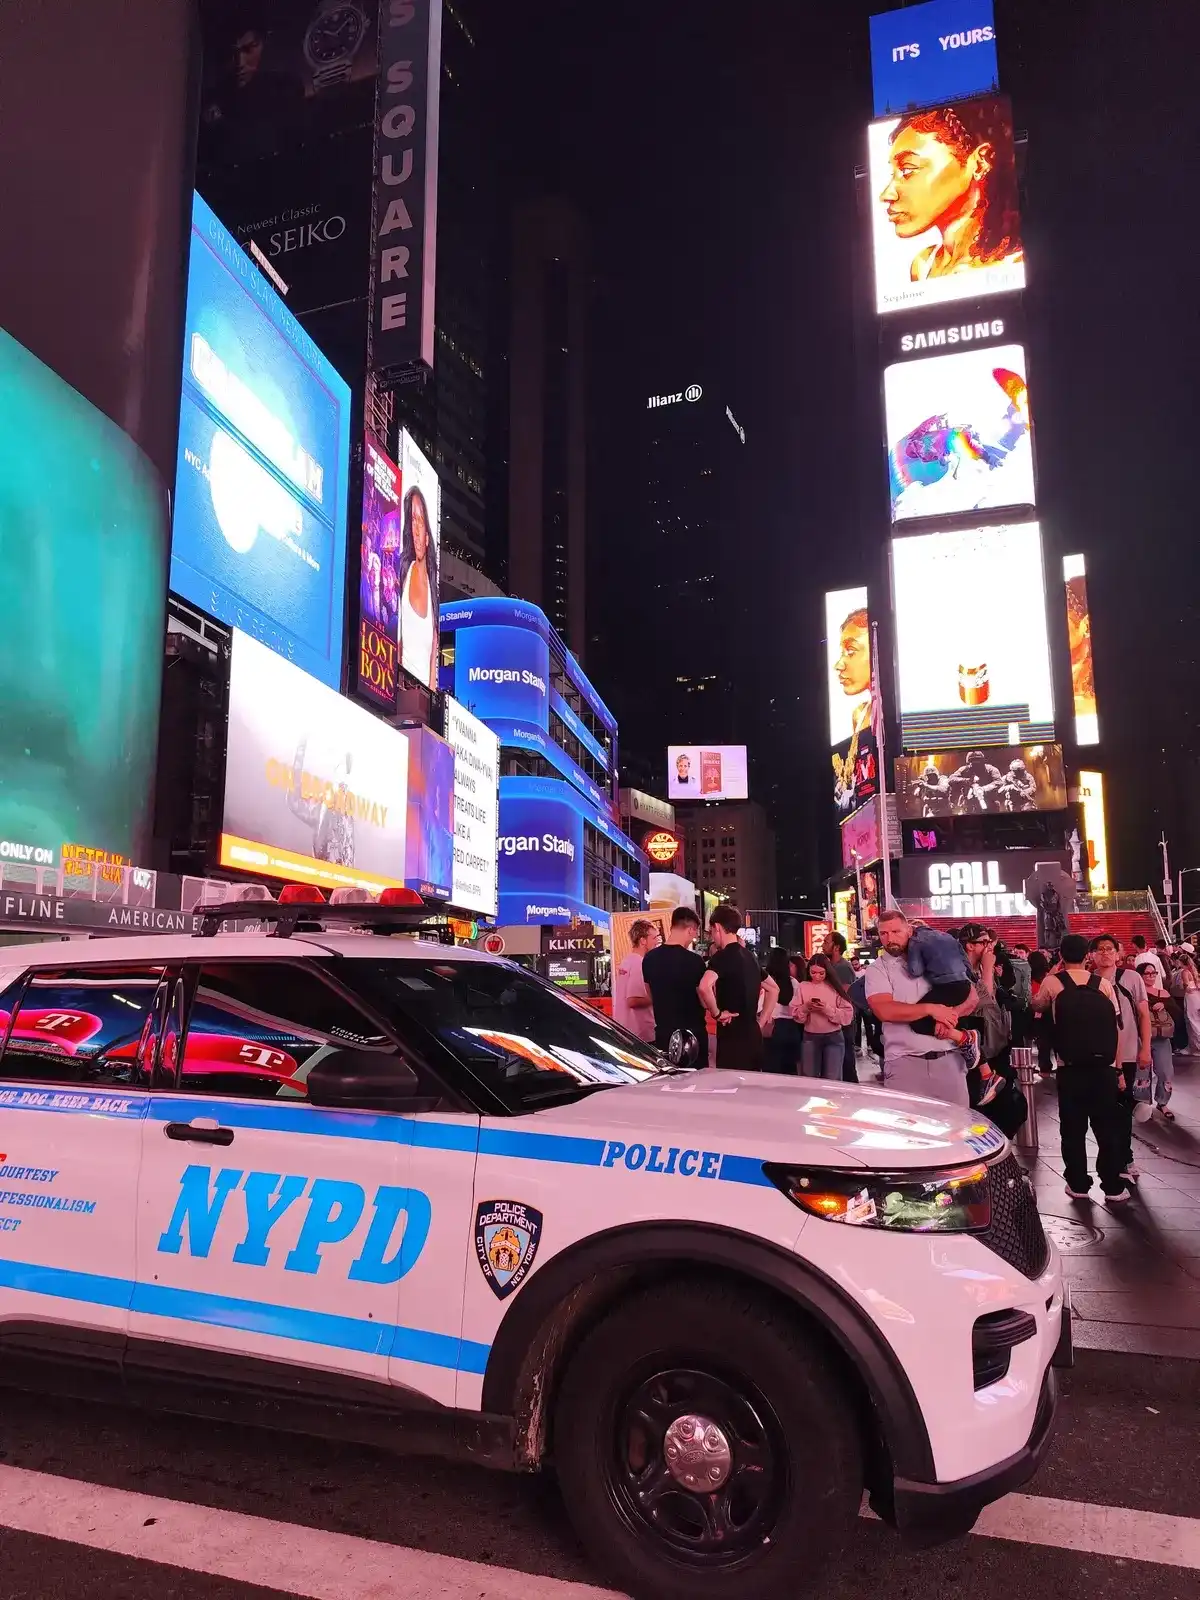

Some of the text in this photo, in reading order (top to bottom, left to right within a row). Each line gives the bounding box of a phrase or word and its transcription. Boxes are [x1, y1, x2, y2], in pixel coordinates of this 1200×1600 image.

[892, 25, 997, 62] IT'S YOURS.
[379, 60, 415, 331] SQUARE
[237, 203, 321, 235] Newest Classic
[208, 219, 248, 277] GRAND
[269, 215, 346, 256] SEIKO
[901, 319, 1005, 352] SAMSUNG
[647, 392, 683, 409] llianz
[184, 448, 201, 472] NYC
[445, 610, 473, 622] Stanley
[361, 622, 396, 674] LOST
[360, 648, 394, 698] BOYS
[469, 667, 521, 684] Morgan
[521, 670, 547, 697] Stanley
[513, 728, 535, 743] Morgan
[454, 768, 476, 794] ALWAYS
[301, 770, 388, 828] BROADWAY
[453, 795, 487, 825] TREATS LIFE
[0, 841, 33, 860] ONLY
[34, 847, 53, 864] ON
[498, 833, 575, 862] rgan Stanley
[928, 861, 1006, 895] CALL
[0, 897, 65, 919] FLINE
[526, 904, 559, 917] Morgan
[930, 895, 951, 911] OF
[108, 908, 185, 930] AMERICAN
[192, 916, 228, 932] ELE
[549, 938, 596, 951] KLIKTIX
[0, 1090, 133, 1113] CE DOG KEEP BACK
[0, 1165, 59, 1183] OURTESY
[603, 1141, 721, 1179] POLICE
[157, 1164, 432, 1285] NYPD
[479, 1213, 538, 1235] DEPARTMENT
[494, 1203, 527, 1217] POLICE
[476, 1236, 493, 1278] CITY OF
[510, 1242, 537, 1287] NEW YORK
